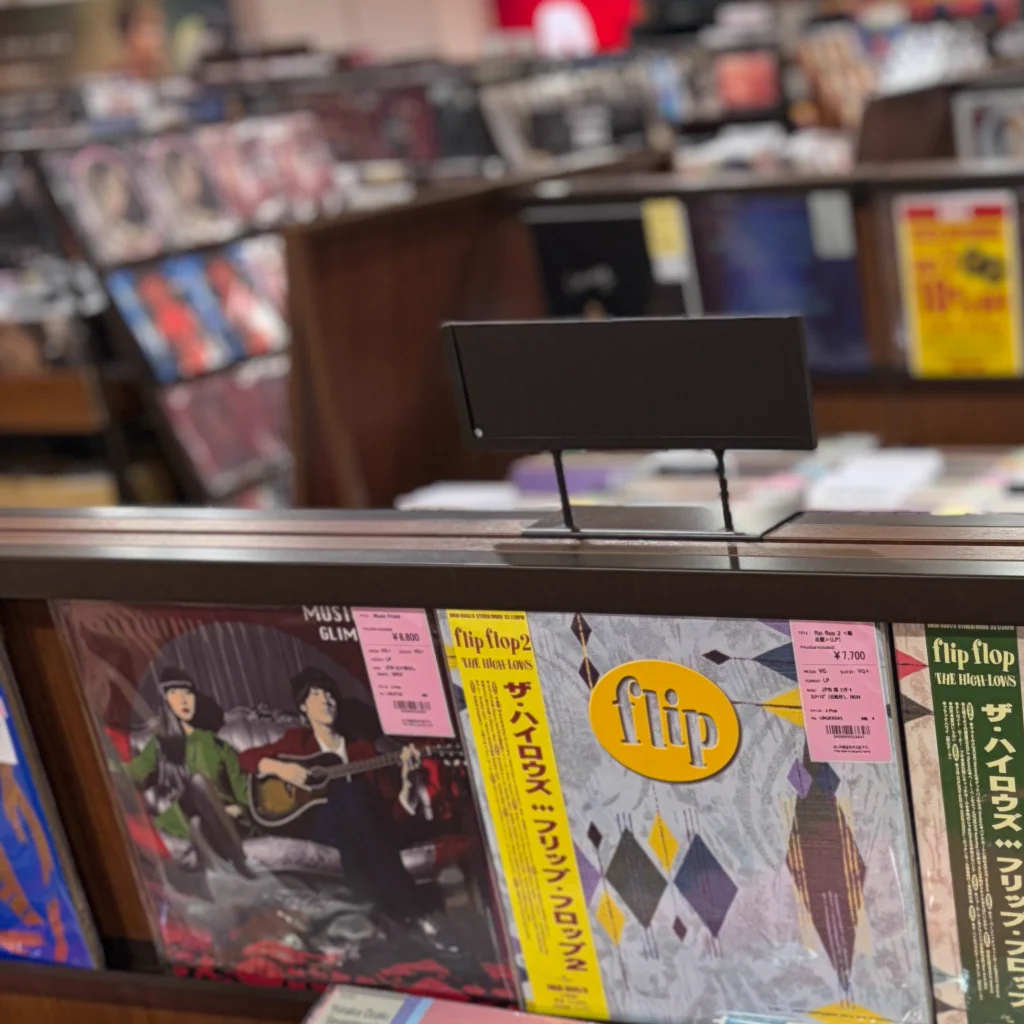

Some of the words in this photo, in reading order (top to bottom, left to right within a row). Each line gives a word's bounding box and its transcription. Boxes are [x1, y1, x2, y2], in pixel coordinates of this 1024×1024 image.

[454, 627, 484, 654] flip
[461, 657, 479, 669] THE
[833, 651, 866, 661] ¥7,700
[932, 638, 969, 670] flip
[972, 638, 1015, 672] flop
[935, 672, 956, 686] THE
[959, 673, 1017, 688] HIGH-LOWS
[612, 675, 719, 768] flip
[981, 703, 1022, 832] ザ・ハイロウズ
